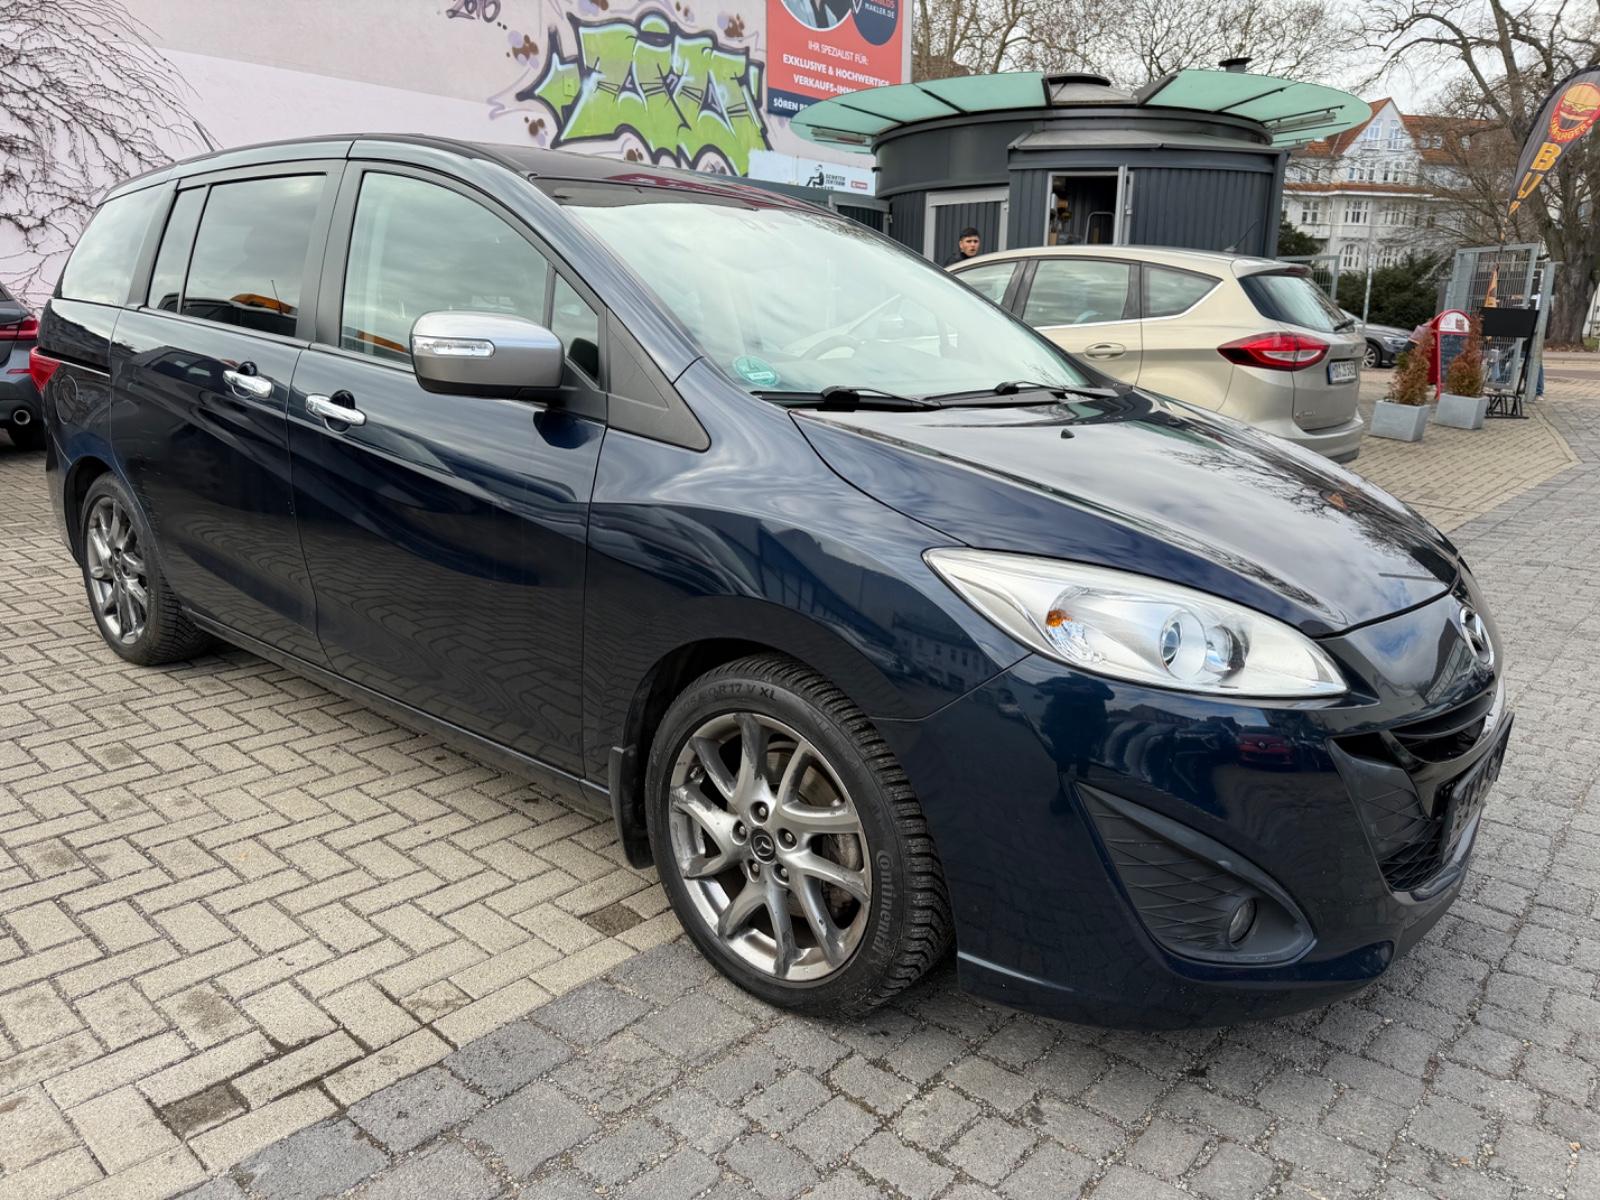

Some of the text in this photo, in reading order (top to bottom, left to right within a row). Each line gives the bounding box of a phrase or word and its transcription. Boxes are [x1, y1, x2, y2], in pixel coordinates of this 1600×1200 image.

[864, 2, 895, 19] MAKLER.DE
[808, 40, 870, 66] IHR SPEZIALIST FÜR:
[783, 54, 827, 74] EXKLUSIVE
[827, 68, 835, 76] &
[773, 97, 799, 111] SÖREN
